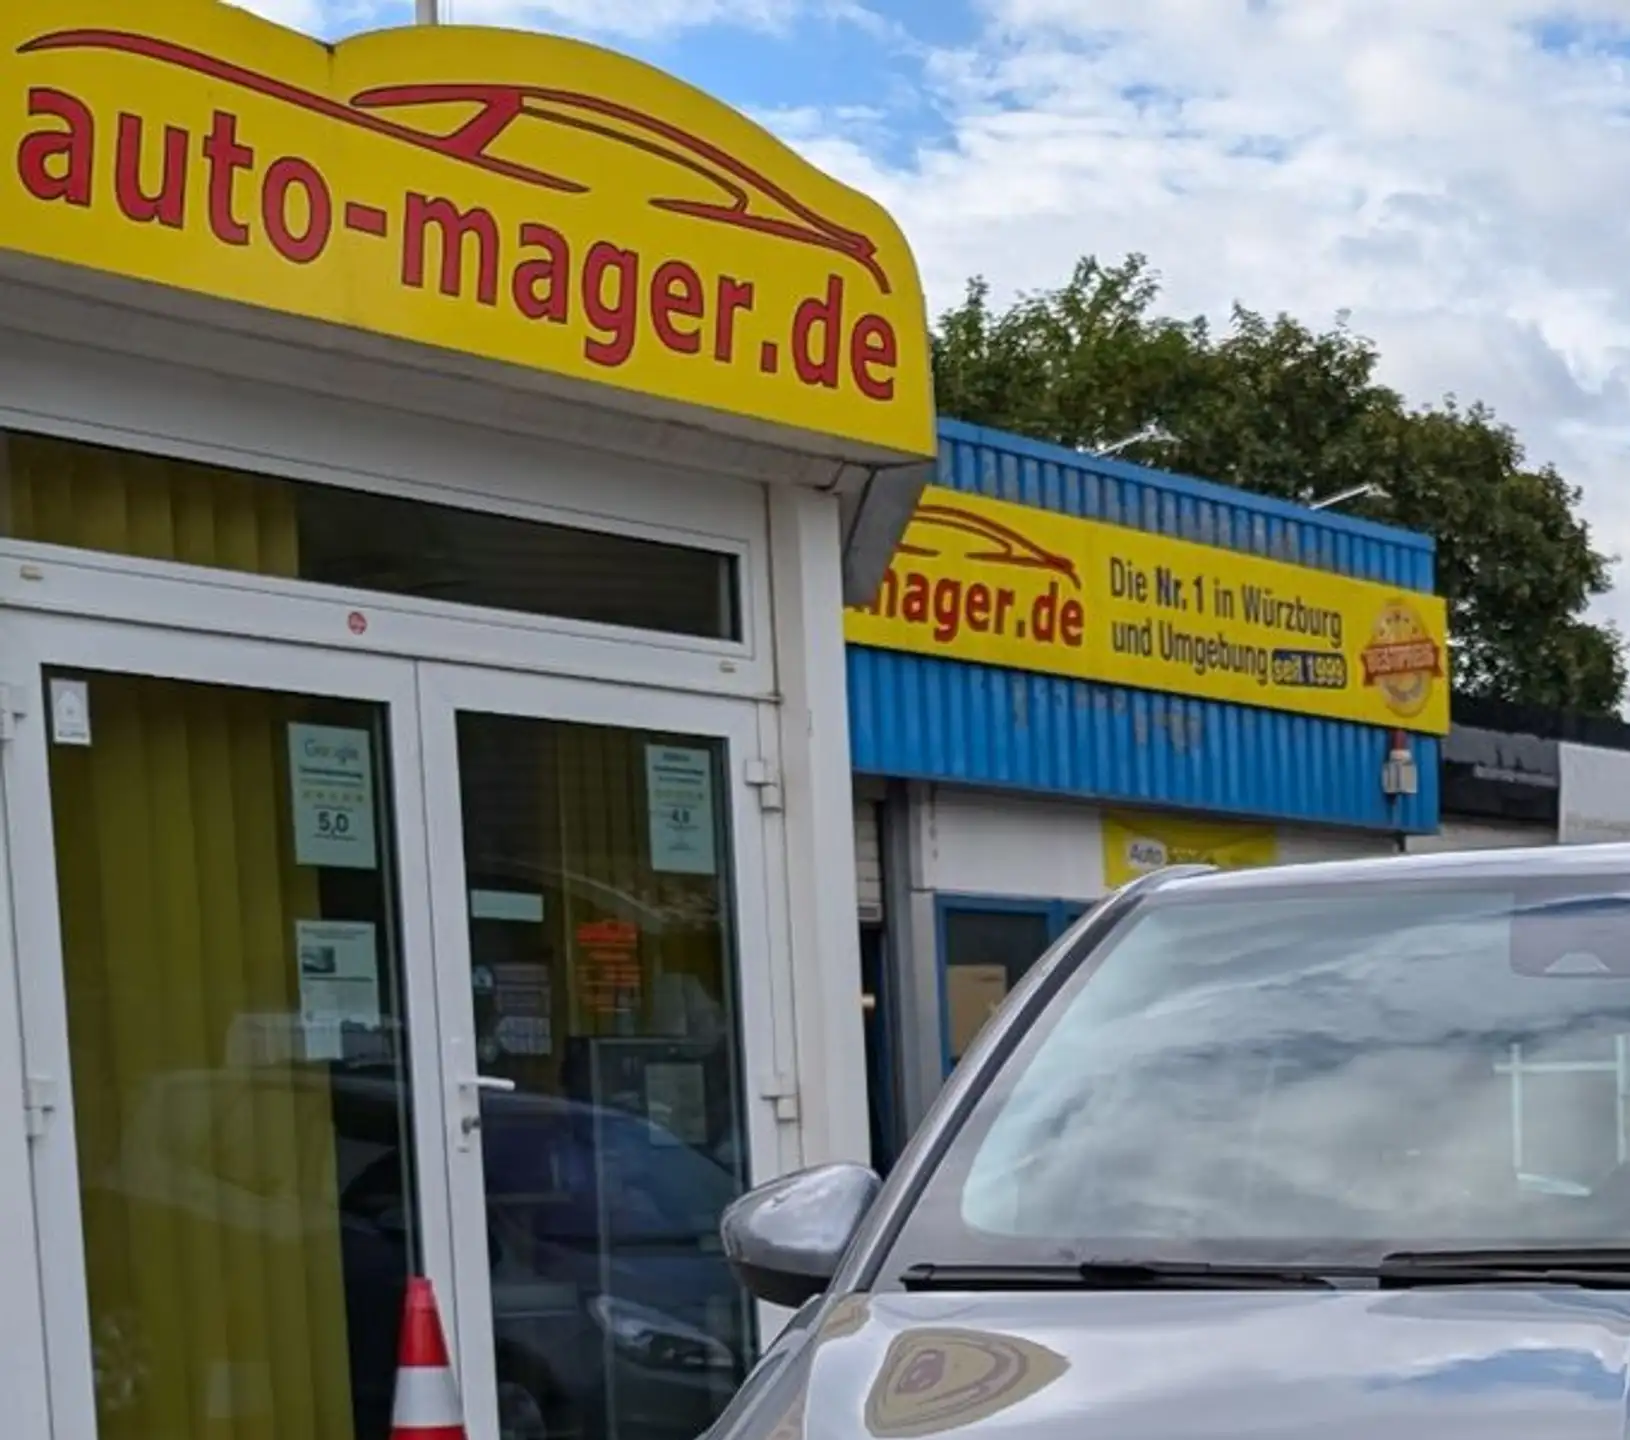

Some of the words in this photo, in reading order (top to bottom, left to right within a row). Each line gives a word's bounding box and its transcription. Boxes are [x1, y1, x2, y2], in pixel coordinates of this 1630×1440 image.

[16, 86, 898, 401] auto-mager.de
[1110, 556, 1148, 602] Die
[1156, 565, 1187, 611] Nr.
[1193, 575, 1204, 614] 1
[1214, 577, 1235, 620] in
[1241, 584, 1342, 648] Würzburg
[1111, 617, 1153, 657] und
[1159, 619, 1269, 686] Umgebung
[318, 810, 350, 834] 5,0
